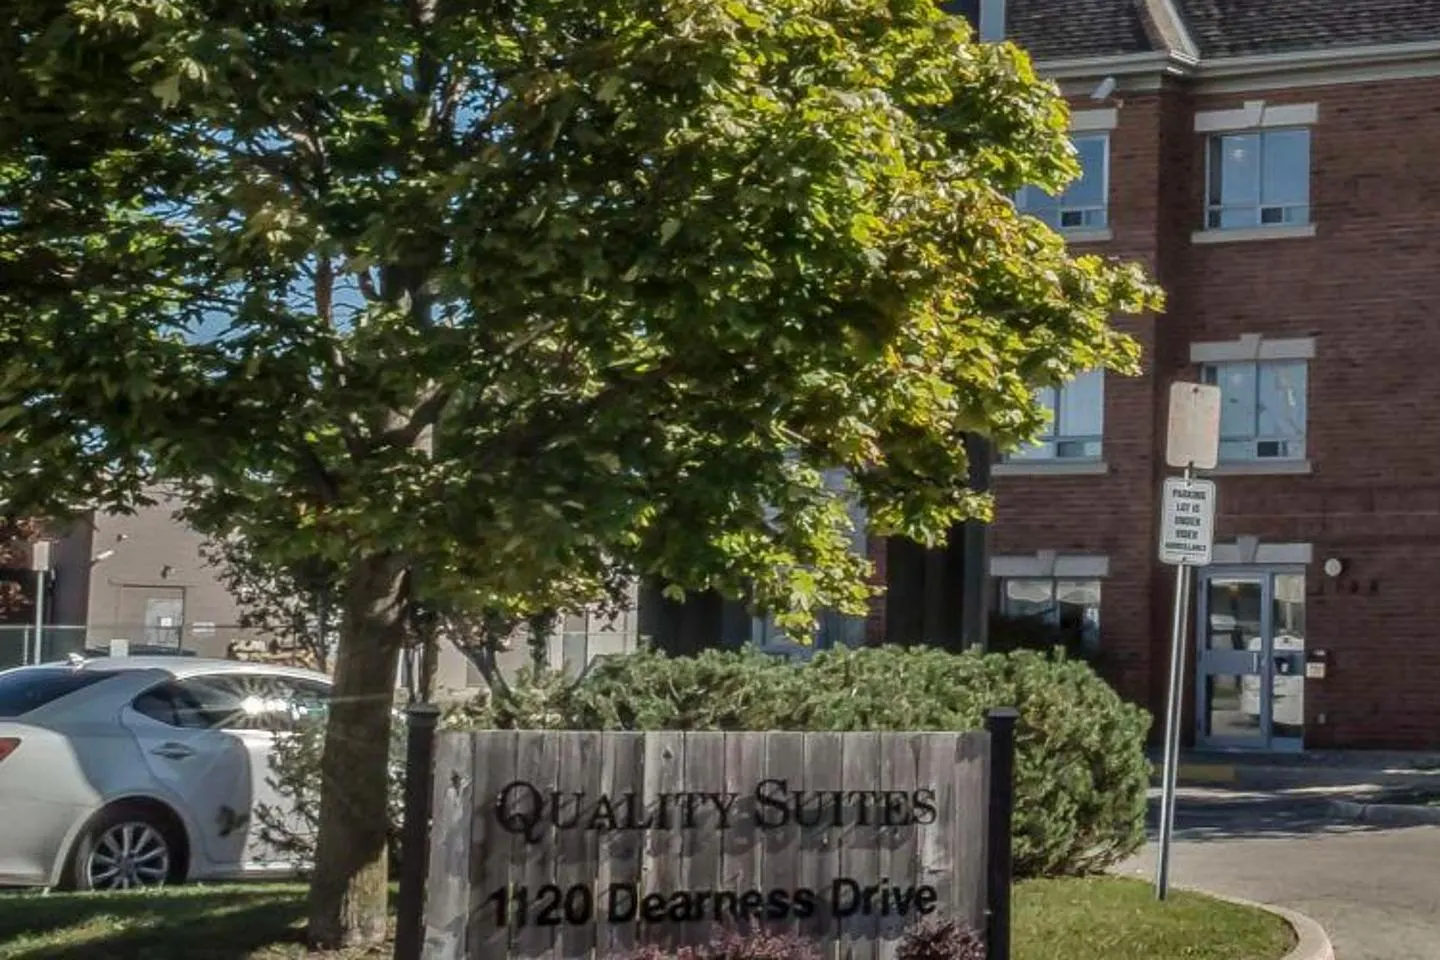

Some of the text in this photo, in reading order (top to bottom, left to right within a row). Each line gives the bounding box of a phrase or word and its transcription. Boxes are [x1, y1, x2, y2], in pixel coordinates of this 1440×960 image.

[1172, 489, 1206, 500] PARKING
[496, 778, 938, 844] QUALITY SUITES
[489, 877, 938, 927] 1120 Dearness Drive
